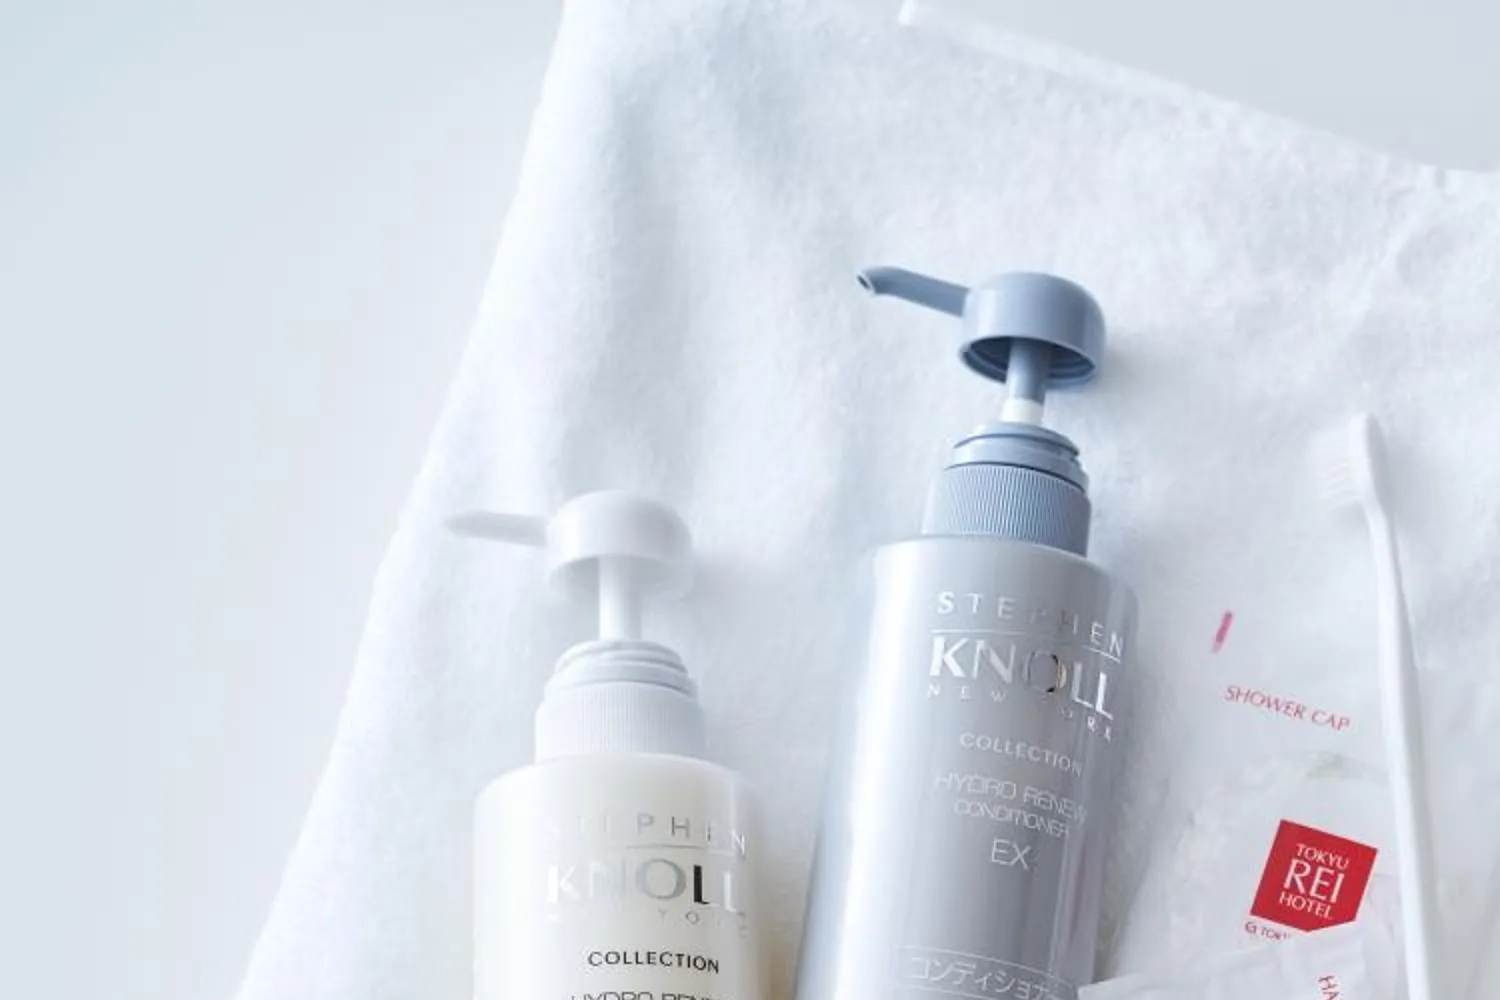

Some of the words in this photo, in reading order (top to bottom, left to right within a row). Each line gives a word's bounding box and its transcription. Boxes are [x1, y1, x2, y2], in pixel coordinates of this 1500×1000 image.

[929, 634, 1115, 721] KNOLL
[1224, 684, 1307, 721] SHOWER
[1311, 708, 1351, 733] CAP
[960, 732, 1083, 778] COLLECTION
[934, 772, 1017, 801] HYDRO
[1023, 784, 1088, 827] RENEW
[954, 799, 1070, 838] CONDITIONER
[991, 838, 1031, 871] EX
[1296, 843, 1350, 871] TOKYU
[1283, 858, 1345, 904] REI
[1279, 891, 1333, 921] HOTEL
[587, 950, 720, 974] COLLECTION
